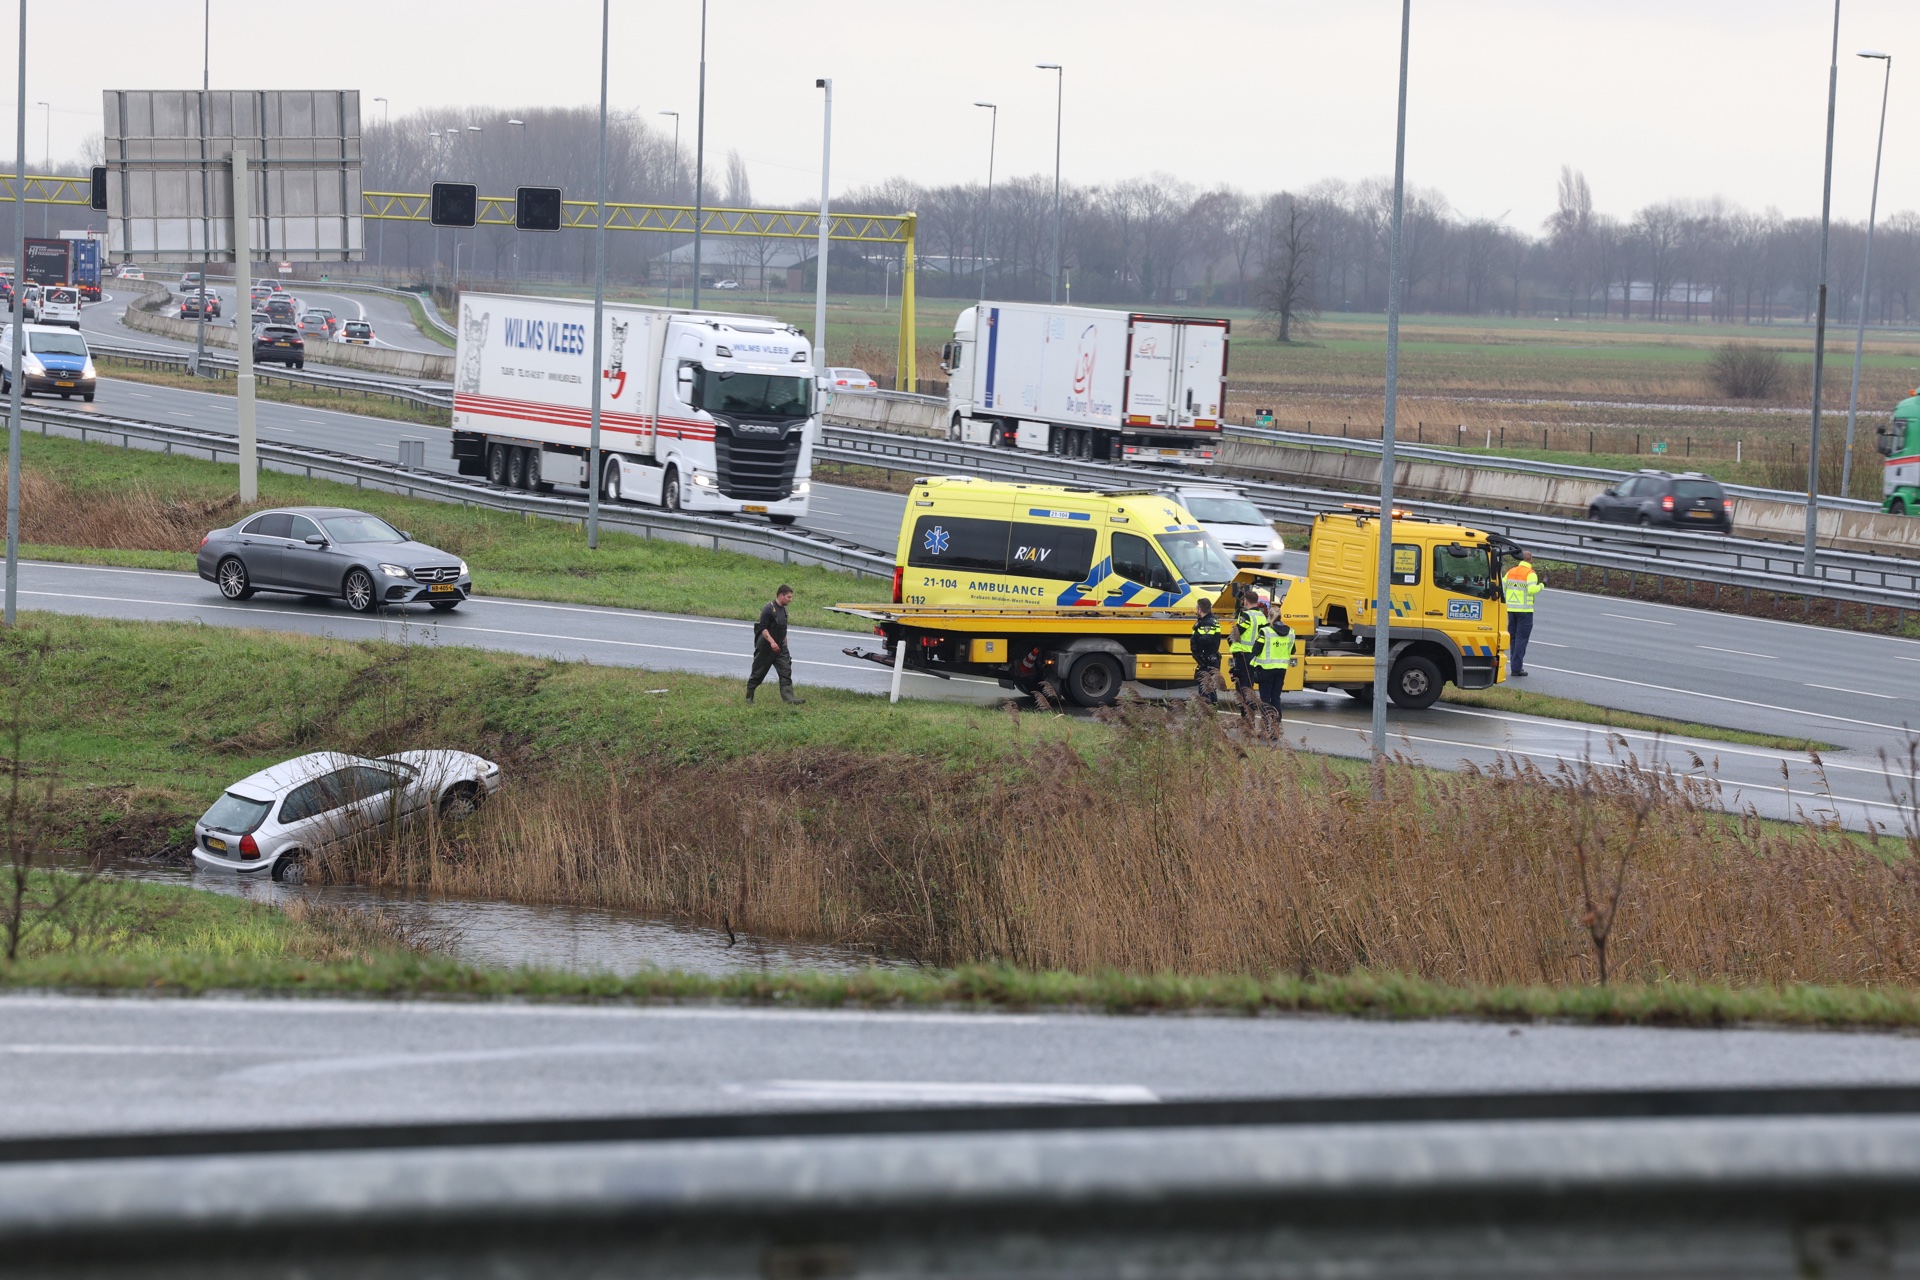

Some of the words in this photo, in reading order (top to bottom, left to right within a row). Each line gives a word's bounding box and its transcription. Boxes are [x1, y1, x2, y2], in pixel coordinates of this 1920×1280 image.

[504, 317, 544, 351] WILMS
[547, 321, 585, 356] VLEES
[733, 344, 760, 353] WILMS
[762, 346, 790, 355] VLEES
[738, 424, 780, 434] SCANIA
[923, 577, 957, 588] 21-104
[969, 581, 1044, 596] AMBULANCE
[911, 595, 926, 605] 112
[1450, 603, 1480, 614] CAR
